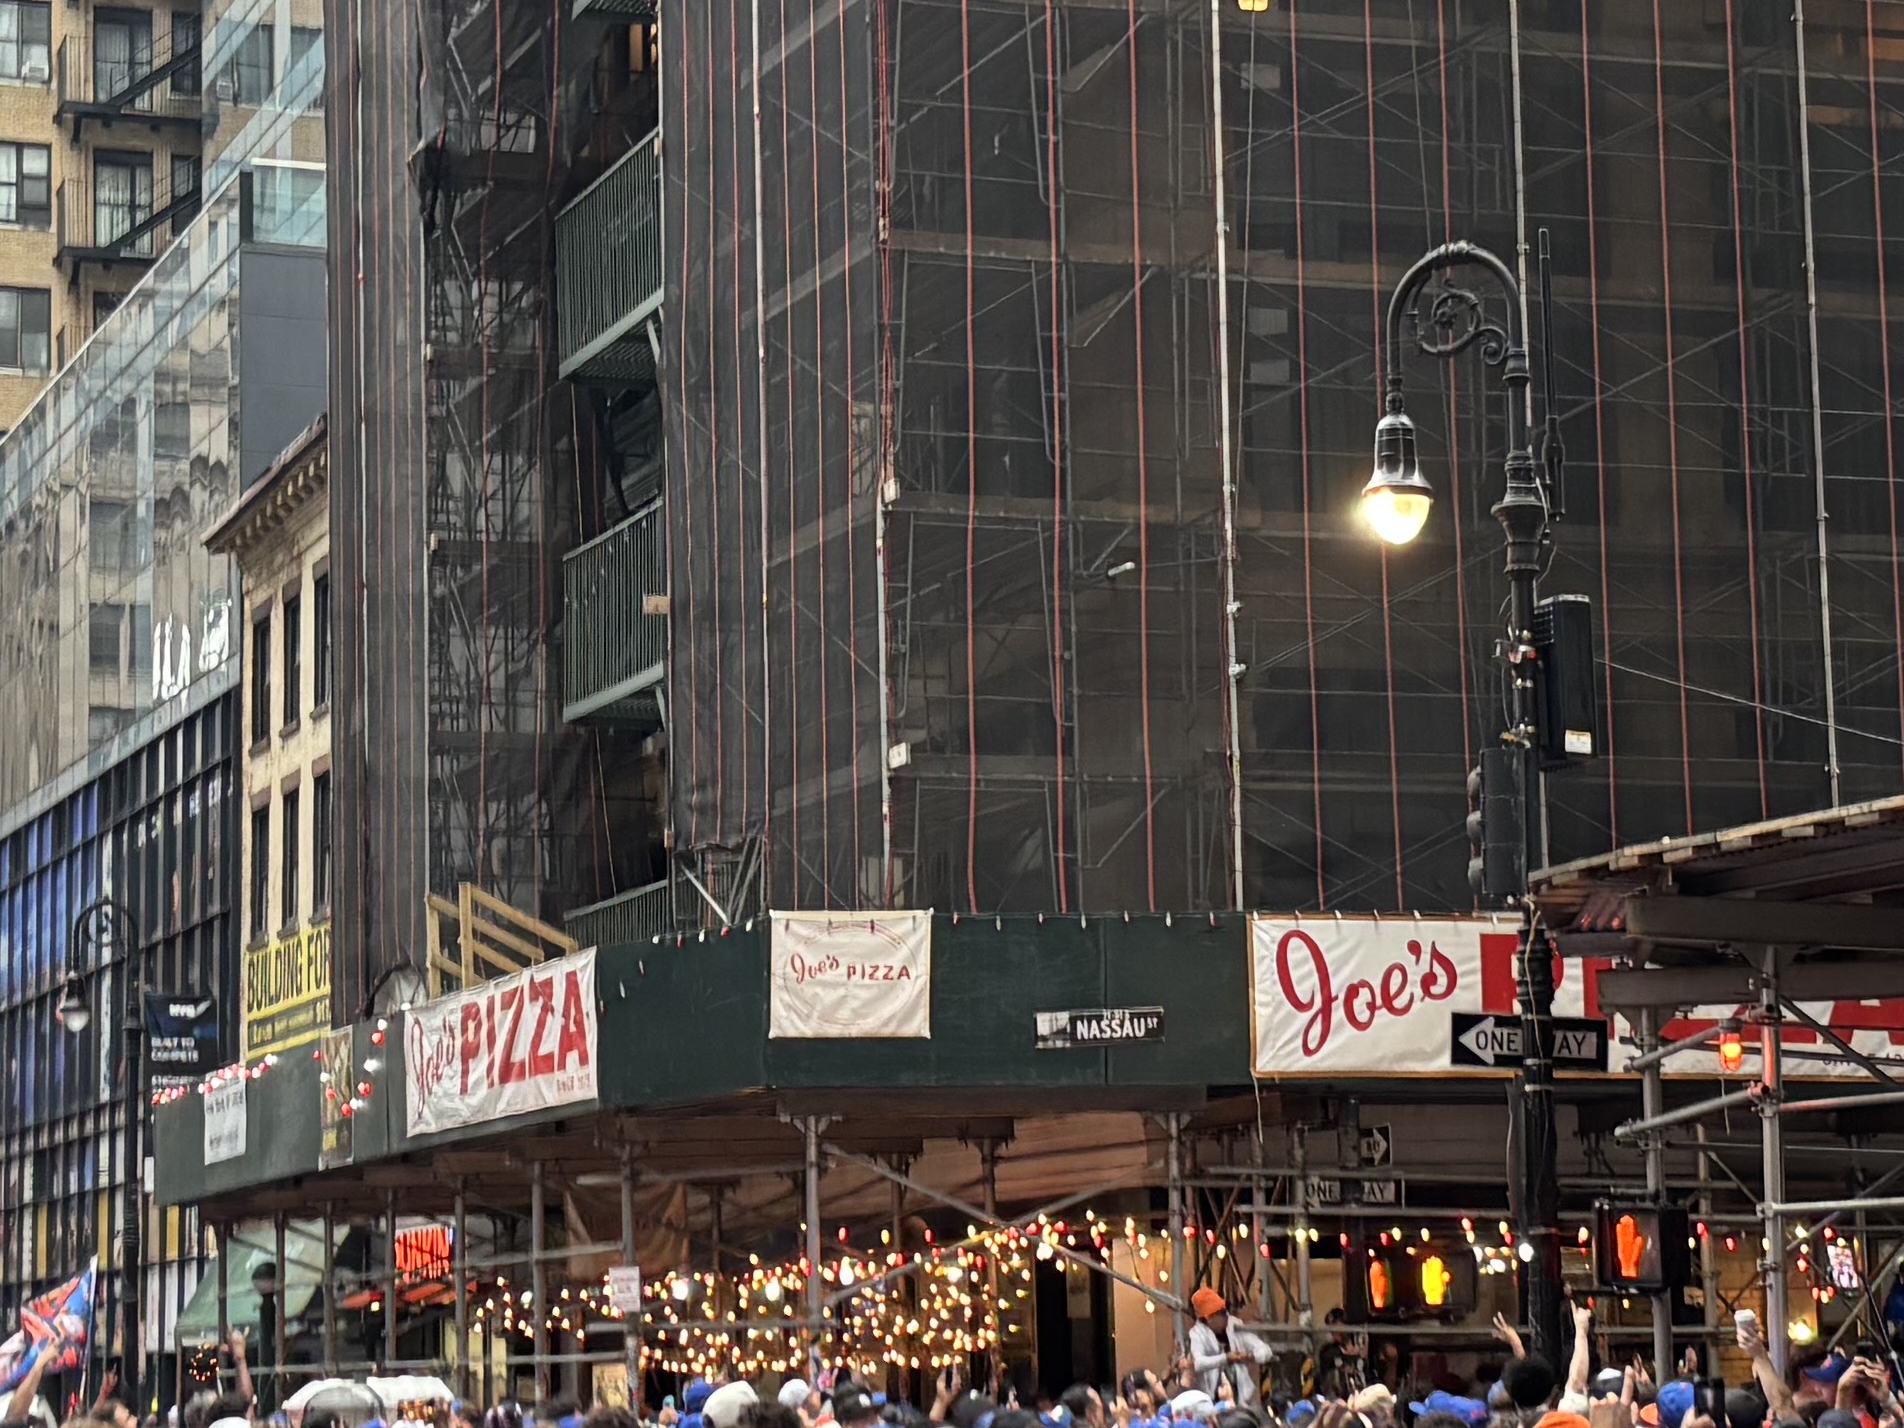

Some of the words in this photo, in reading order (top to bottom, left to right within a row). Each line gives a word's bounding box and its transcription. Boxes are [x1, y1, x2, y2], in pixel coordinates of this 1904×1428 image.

[247, 936, 302, 1014] BUILDING
[790, 952, 840, 985] Joe's
[847, 964, 912, 981] PIZZA
[1276, 929, 1458, 1057] Joe's
[460, 969, 590, 1096] PIZZA
[1076, 1017, 1145, 1040] NASSAU
[1146, 1017, 1159, 1029] ST
[1475, 1031, 1518, 1052] ONE
[1555, 1032, 1587, 1056] AY
